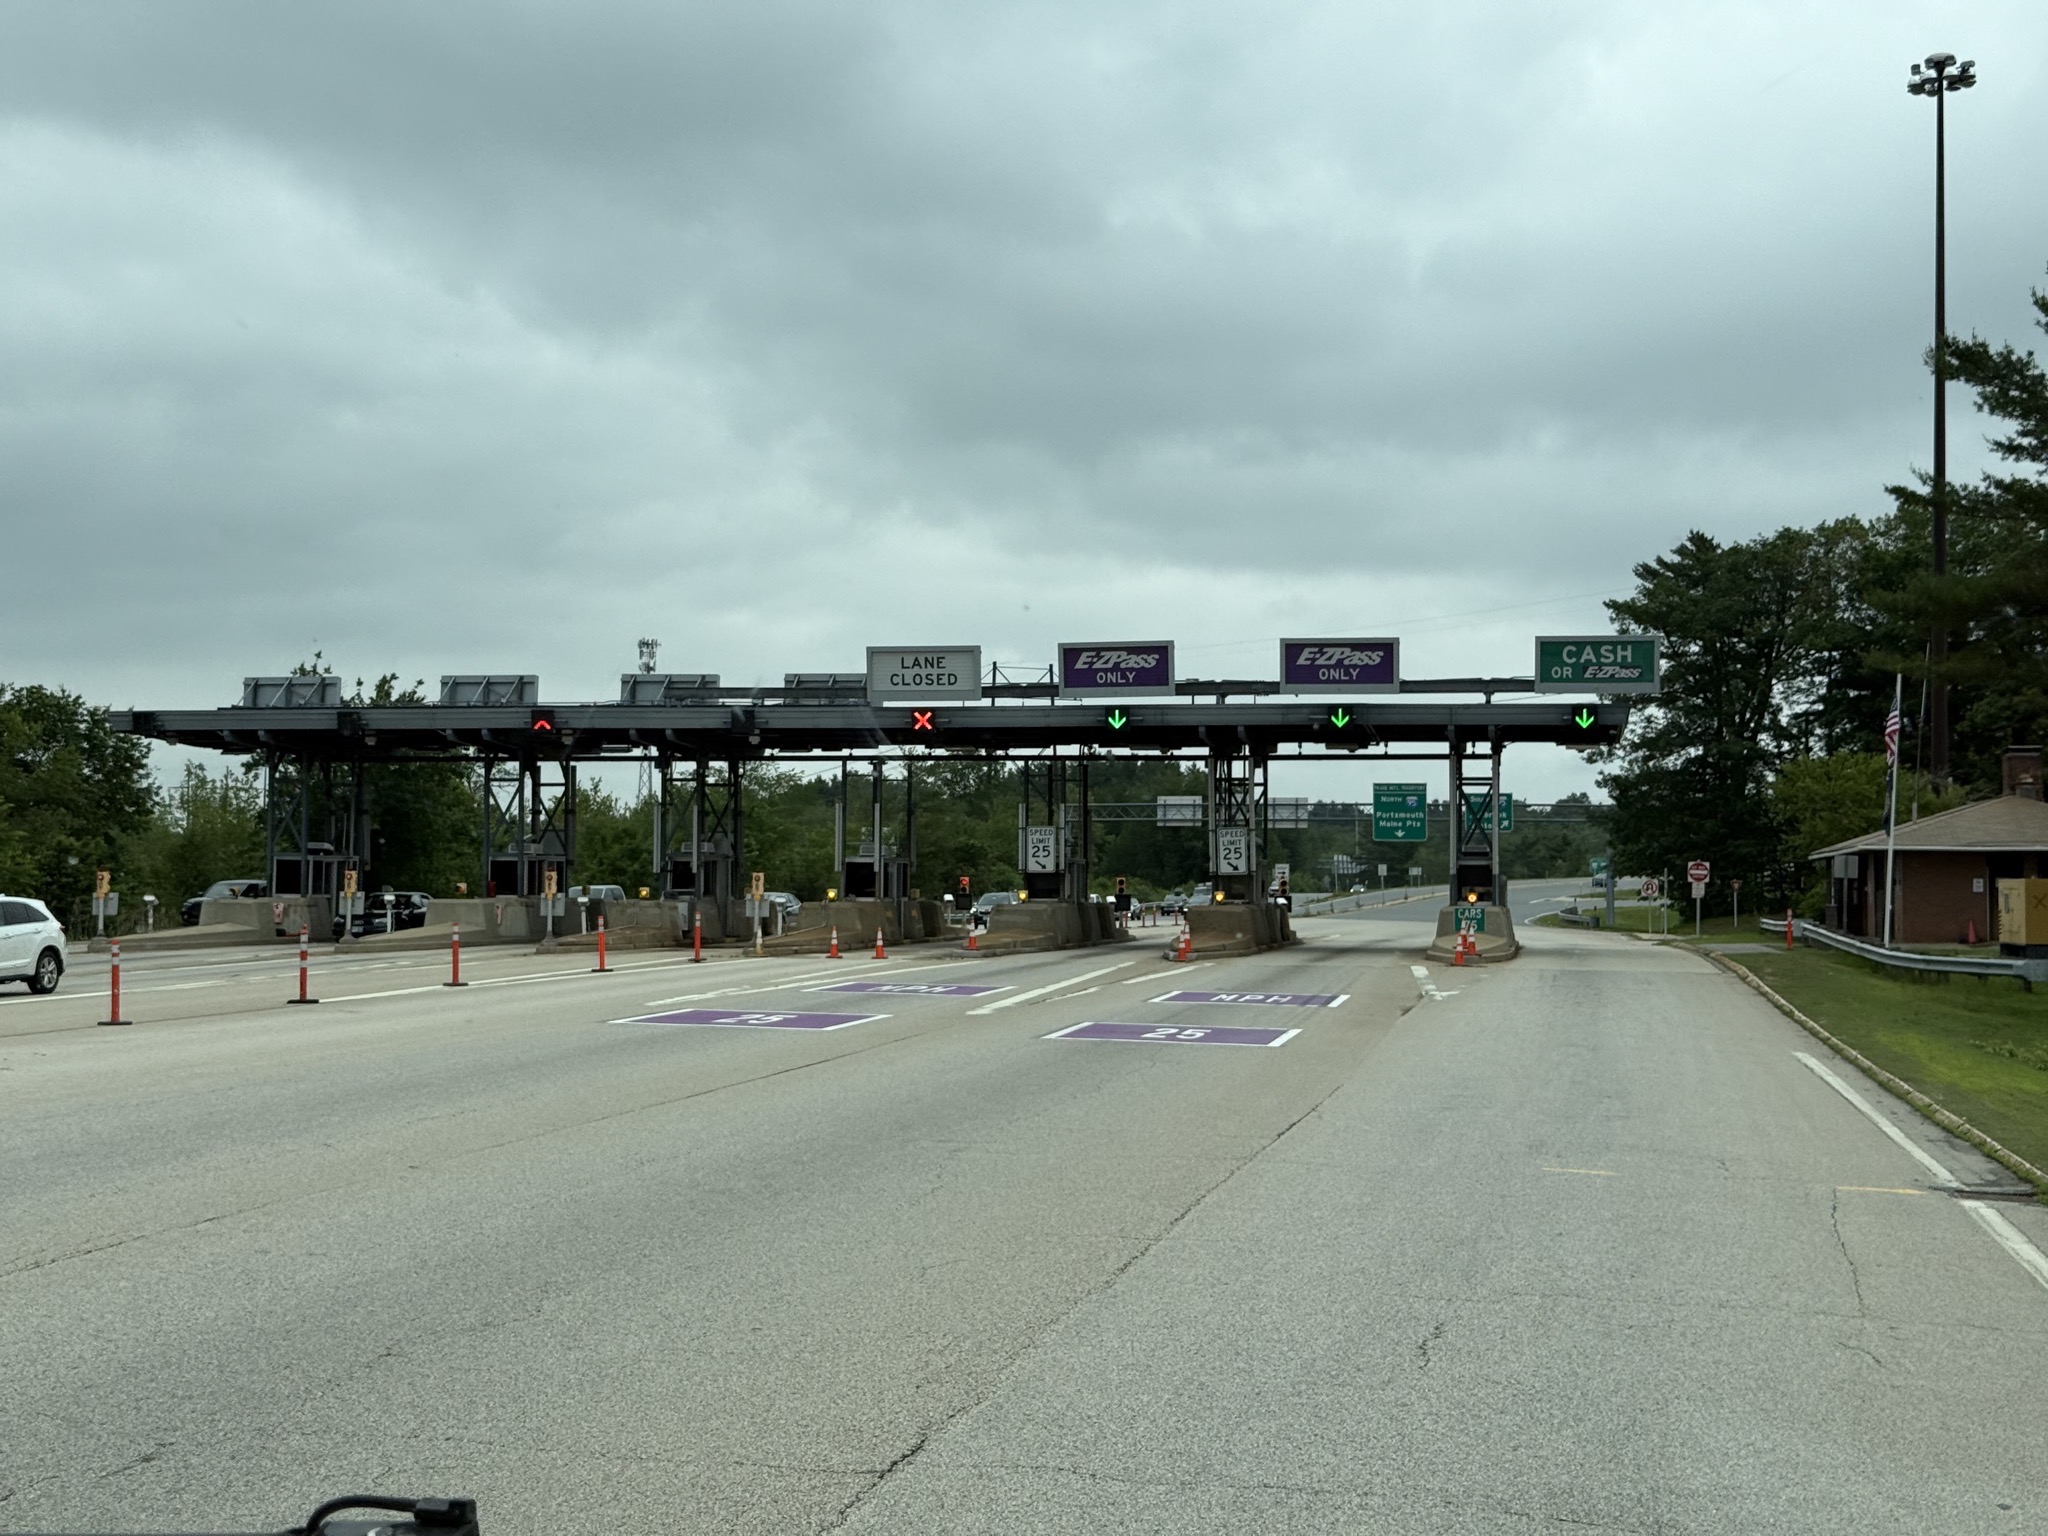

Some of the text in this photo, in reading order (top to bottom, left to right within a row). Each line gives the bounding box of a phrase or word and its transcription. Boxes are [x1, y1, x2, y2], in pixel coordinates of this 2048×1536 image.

[1562, 644, 1632, 663] CASH
[900, 656, 946, 670] LANE
[1096, 671, 1137, 684] ONLY
[1318, 668, 1360, 680] ONLY
[1551, 666, 1573, 679] OR
[889, 673, 958, 686] CLOSED
[1376, 811, 1424, 819] Portsmouth
[1379, 820, 1421, 828] Maine Pts
[1029, 829, 1054, 837] SPEED
[1219, 830, 1245, 838] SPEED
[1222, 839, 1242, 847] LIMIT
[1031, 845, 1051, 858] 25
[1223, 847, 1243, 860] 25
[1457, 908, 1482, 919] CARS
[1209, 993, 1294, 1004] MPH
[711, 1013, 799, 1025] 25
[1140, 1027, 1212, 1040] 25
